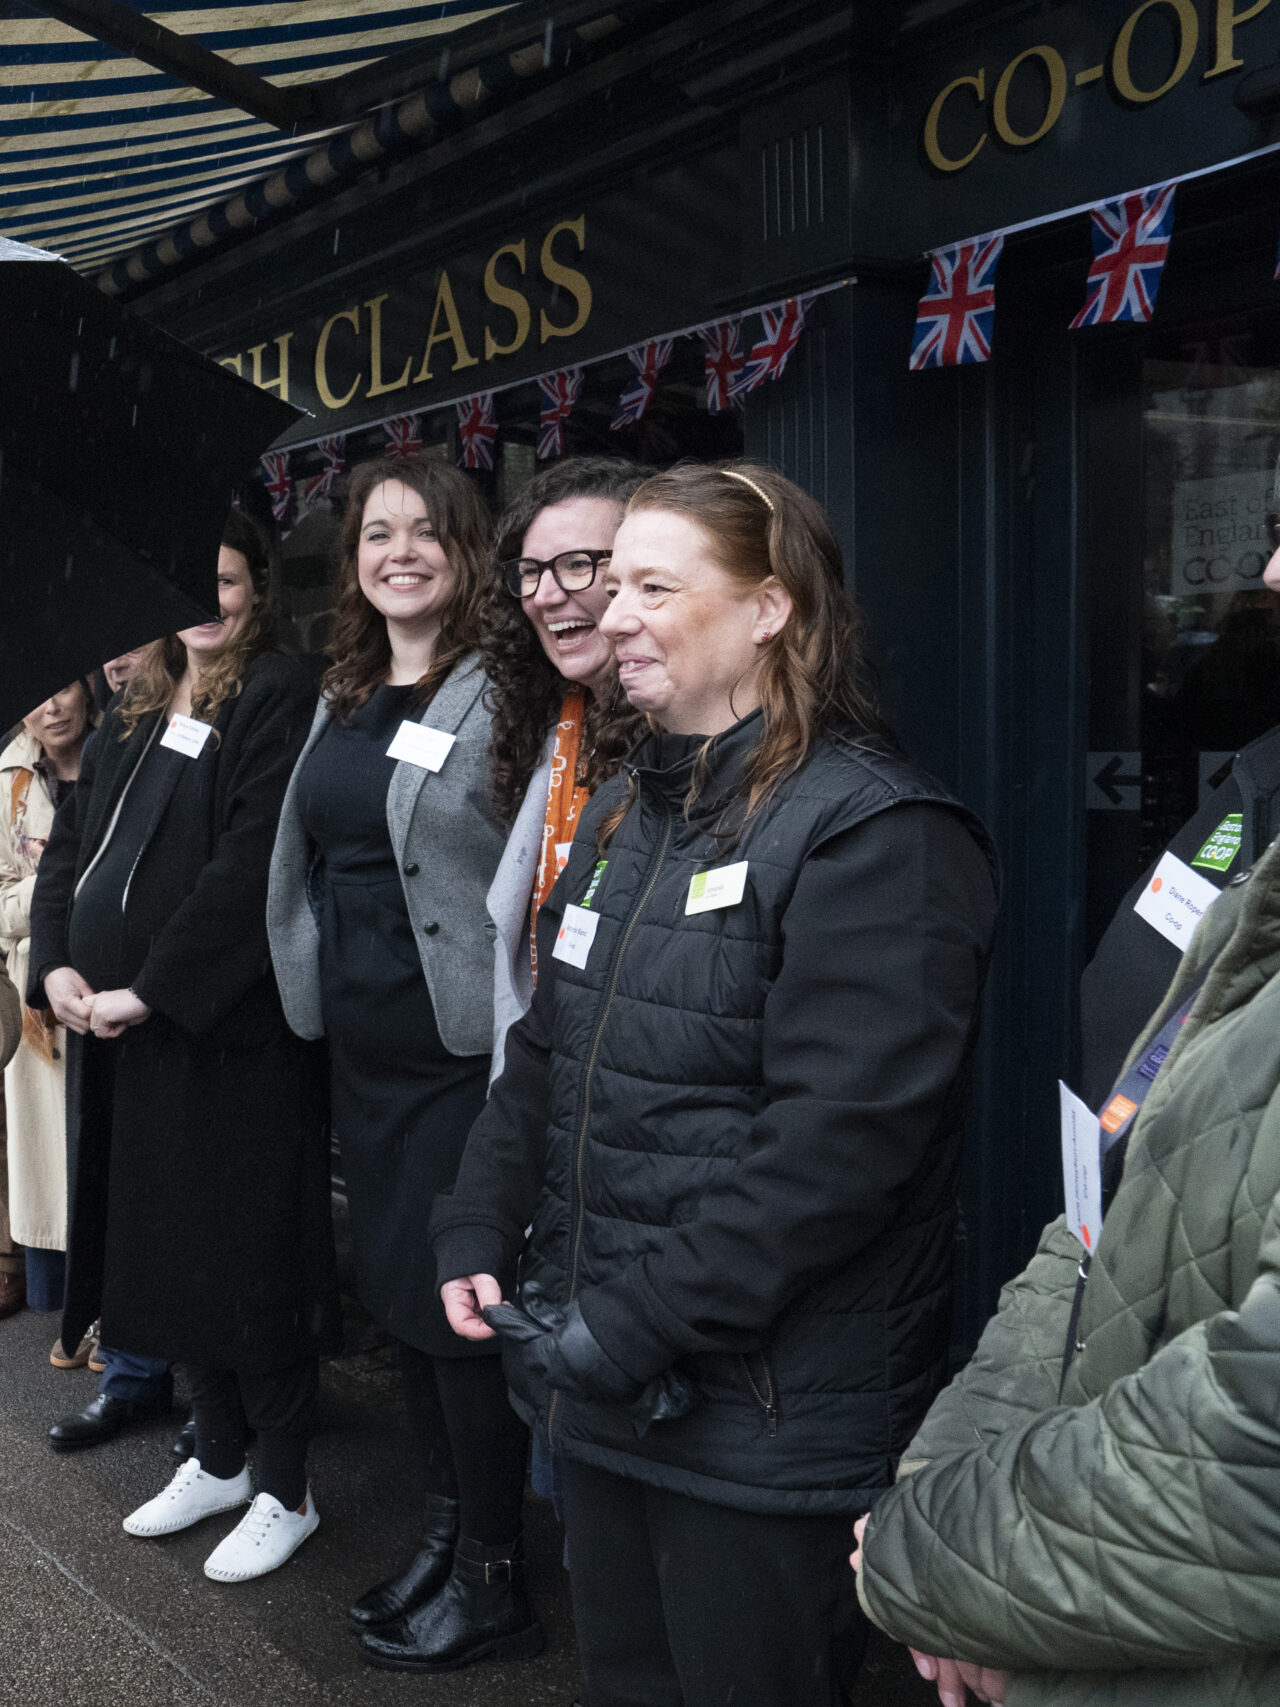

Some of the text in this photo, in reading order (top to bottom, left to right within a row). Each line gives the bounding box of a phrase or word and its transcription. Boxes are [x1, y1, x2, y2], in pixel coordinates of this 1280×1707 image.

[924, 0, 1271, 171] CO-OP
[315, 214, 593, 409] CLASS
[1184, 496, 1238, 521] East
